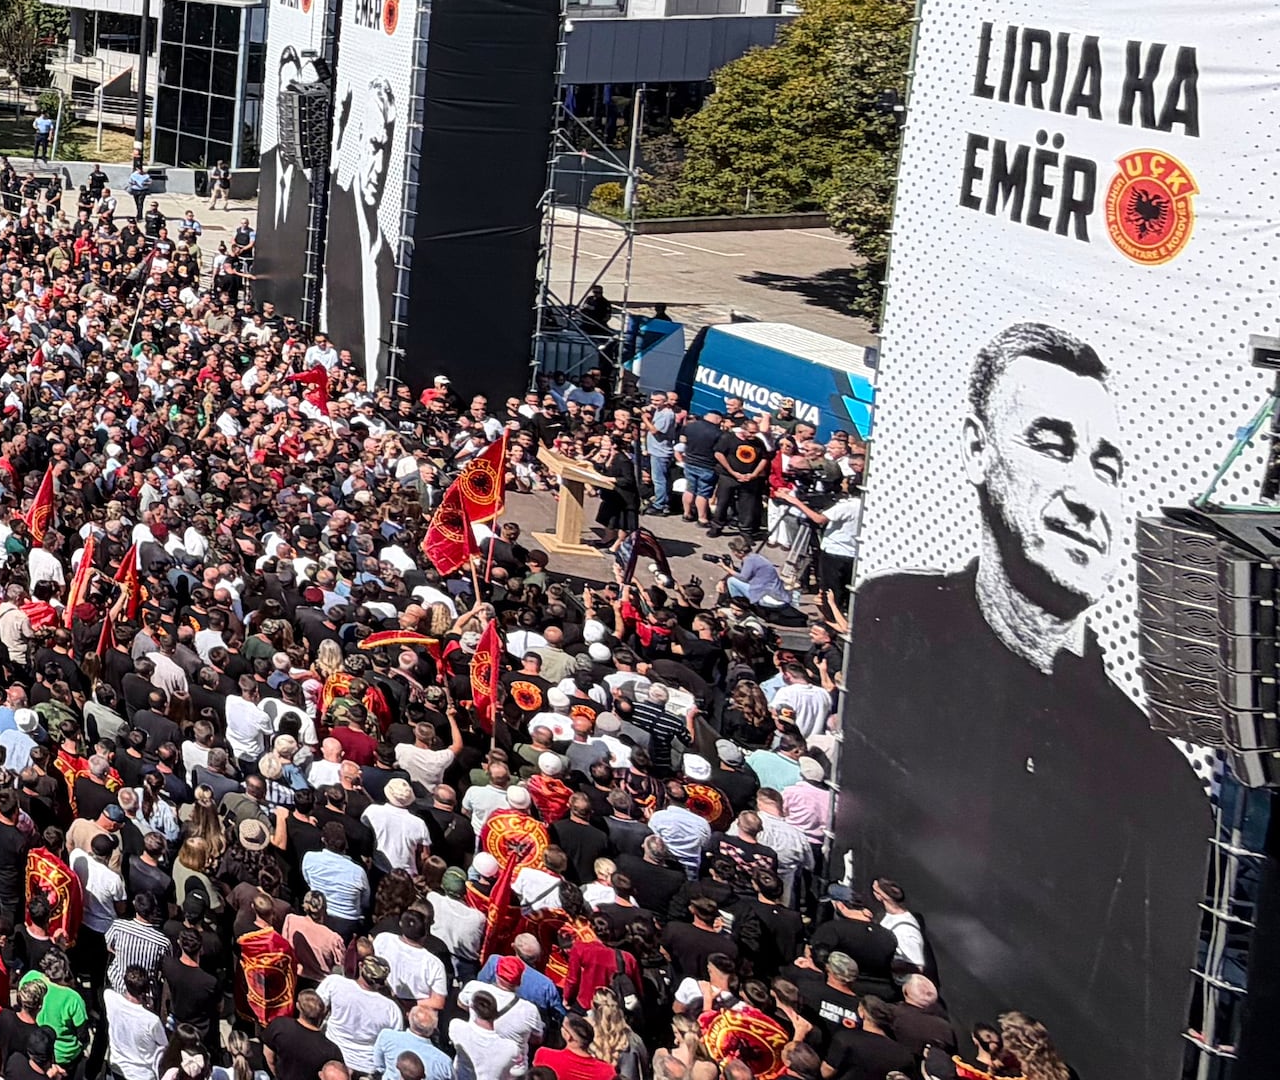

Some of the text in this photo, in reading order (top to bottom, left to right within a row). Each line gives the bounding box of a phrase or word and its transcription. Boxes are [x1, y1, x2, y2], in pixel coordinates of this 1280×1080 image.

[972, 21, 1201, 138] LIRIA KA
[958, 128, 1098, 243] EMËR
[1125, 155, 1188, 195] UÇK
[694, 365, 821, 426] KLANKOSVA
